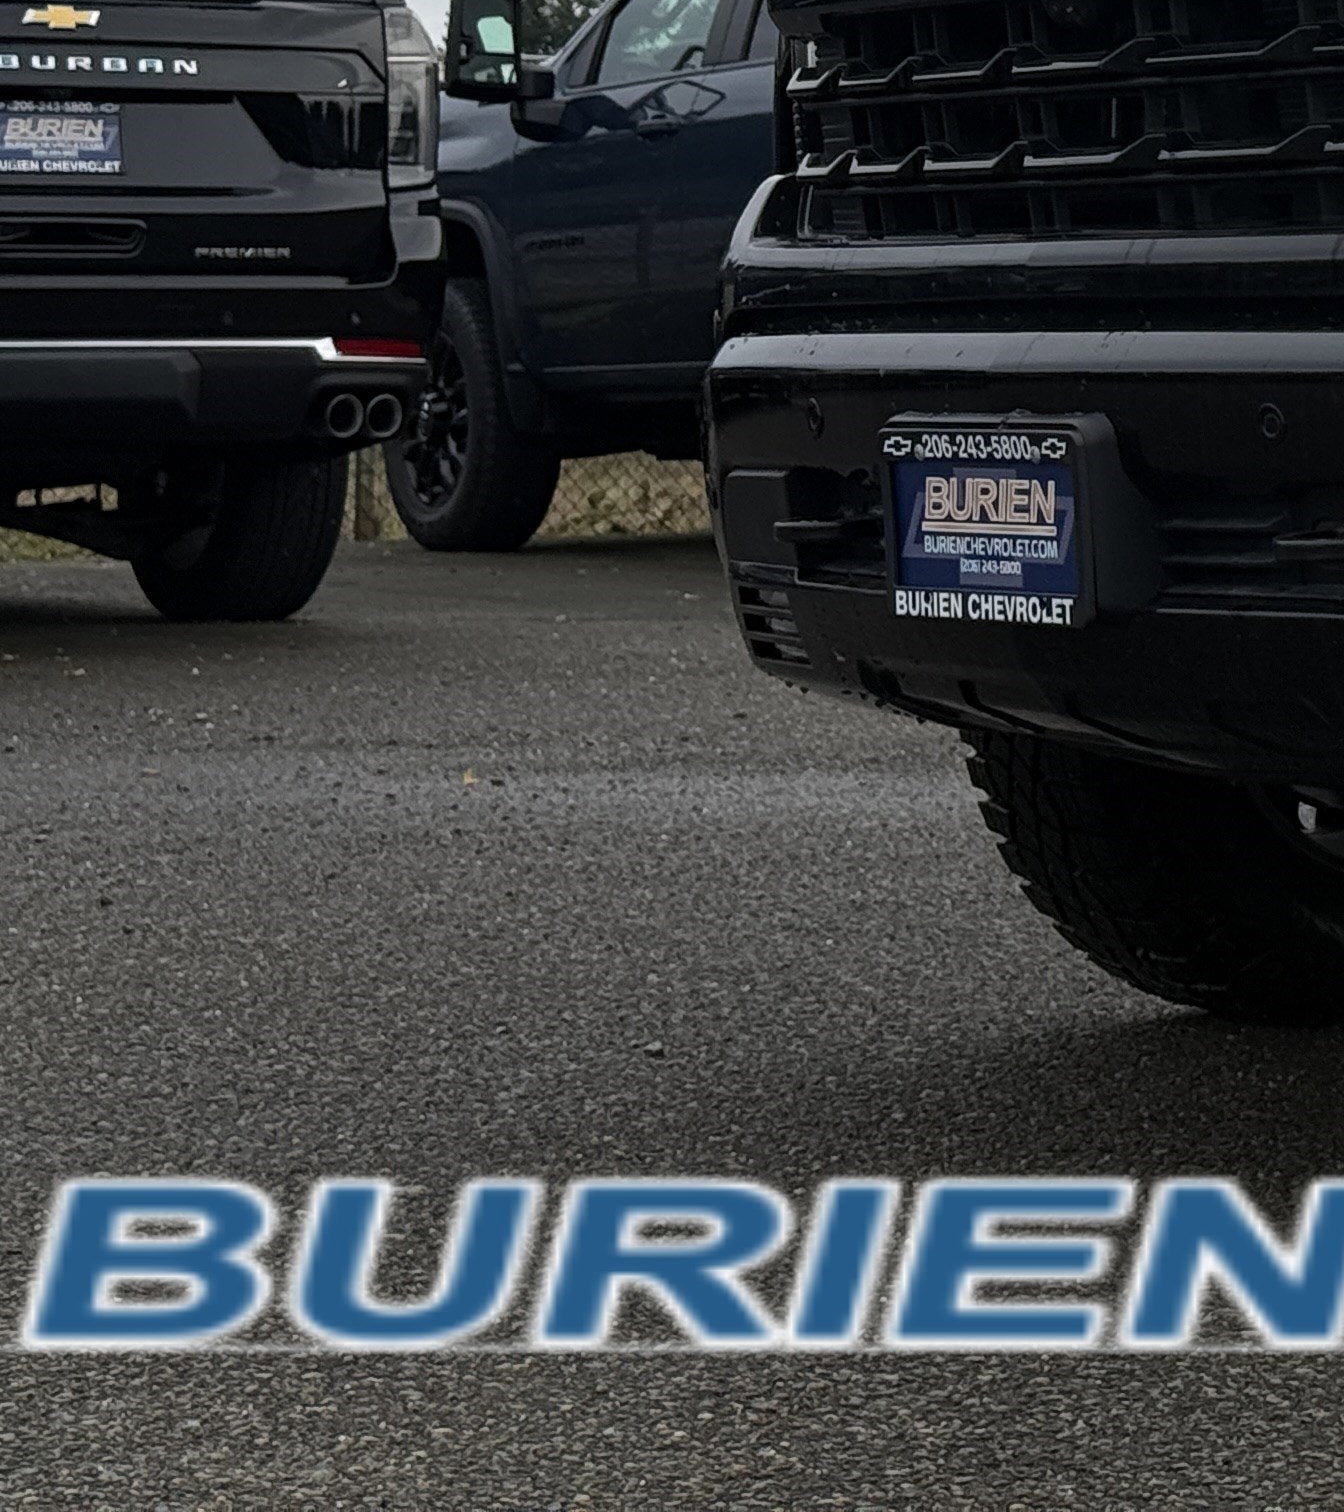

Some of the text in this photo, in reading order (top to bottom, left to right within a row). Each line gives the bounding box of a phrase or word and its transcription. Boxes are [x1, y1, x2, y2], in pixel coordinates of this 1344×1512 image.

[6, 118, 104, 138] BURIEN
[921, 434, 1032, 461] 206-243-5800
[924, 476, 1056, 524] BURIEN
[923, 534, 1059, 559] BURIENCHEVROLET.COM
